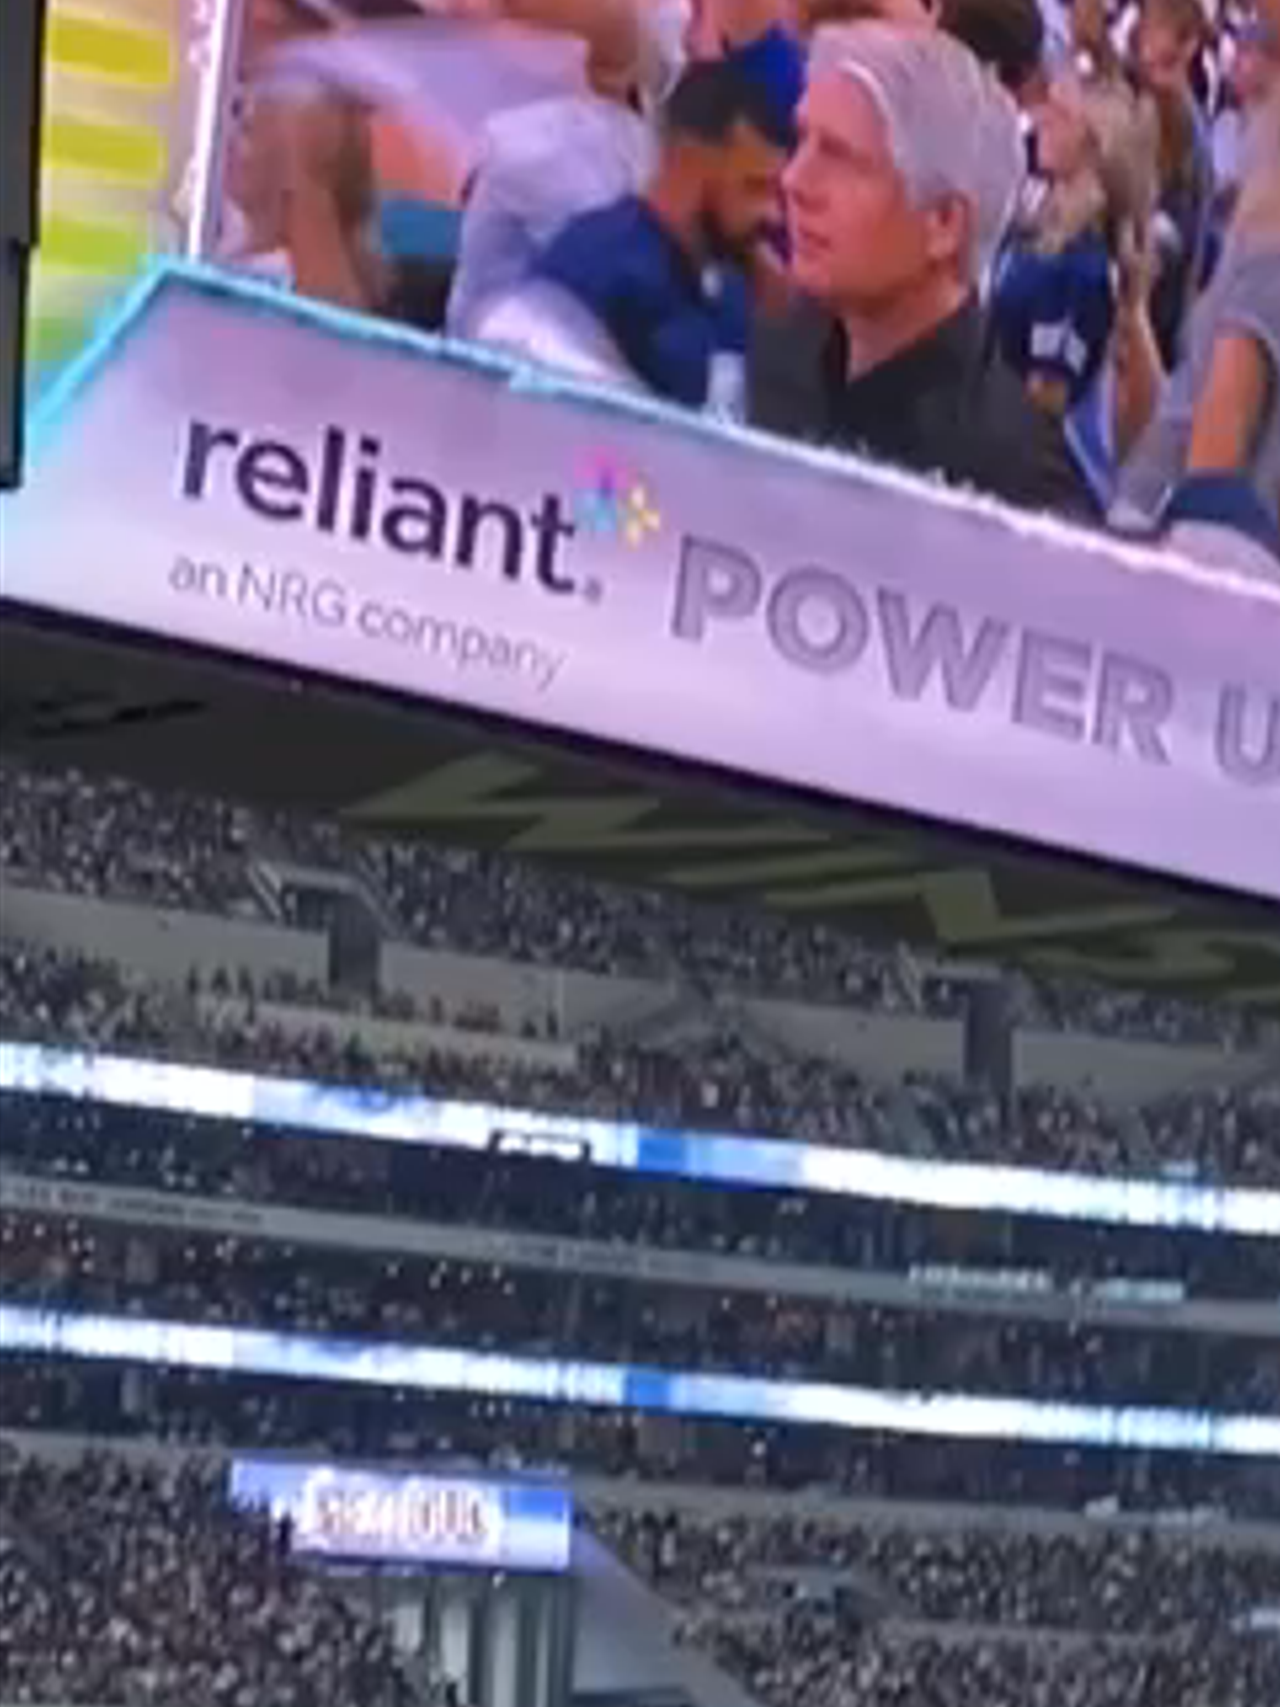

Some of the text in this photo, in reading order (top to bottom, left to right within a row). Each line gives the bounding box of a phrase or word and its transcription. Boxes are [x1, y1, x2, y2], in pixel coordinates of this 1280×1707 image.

[180, 418, 578, 596] reliant
[168, 555, 568, 692] an NRG company
[669, 533, 1182, 765] POWER
